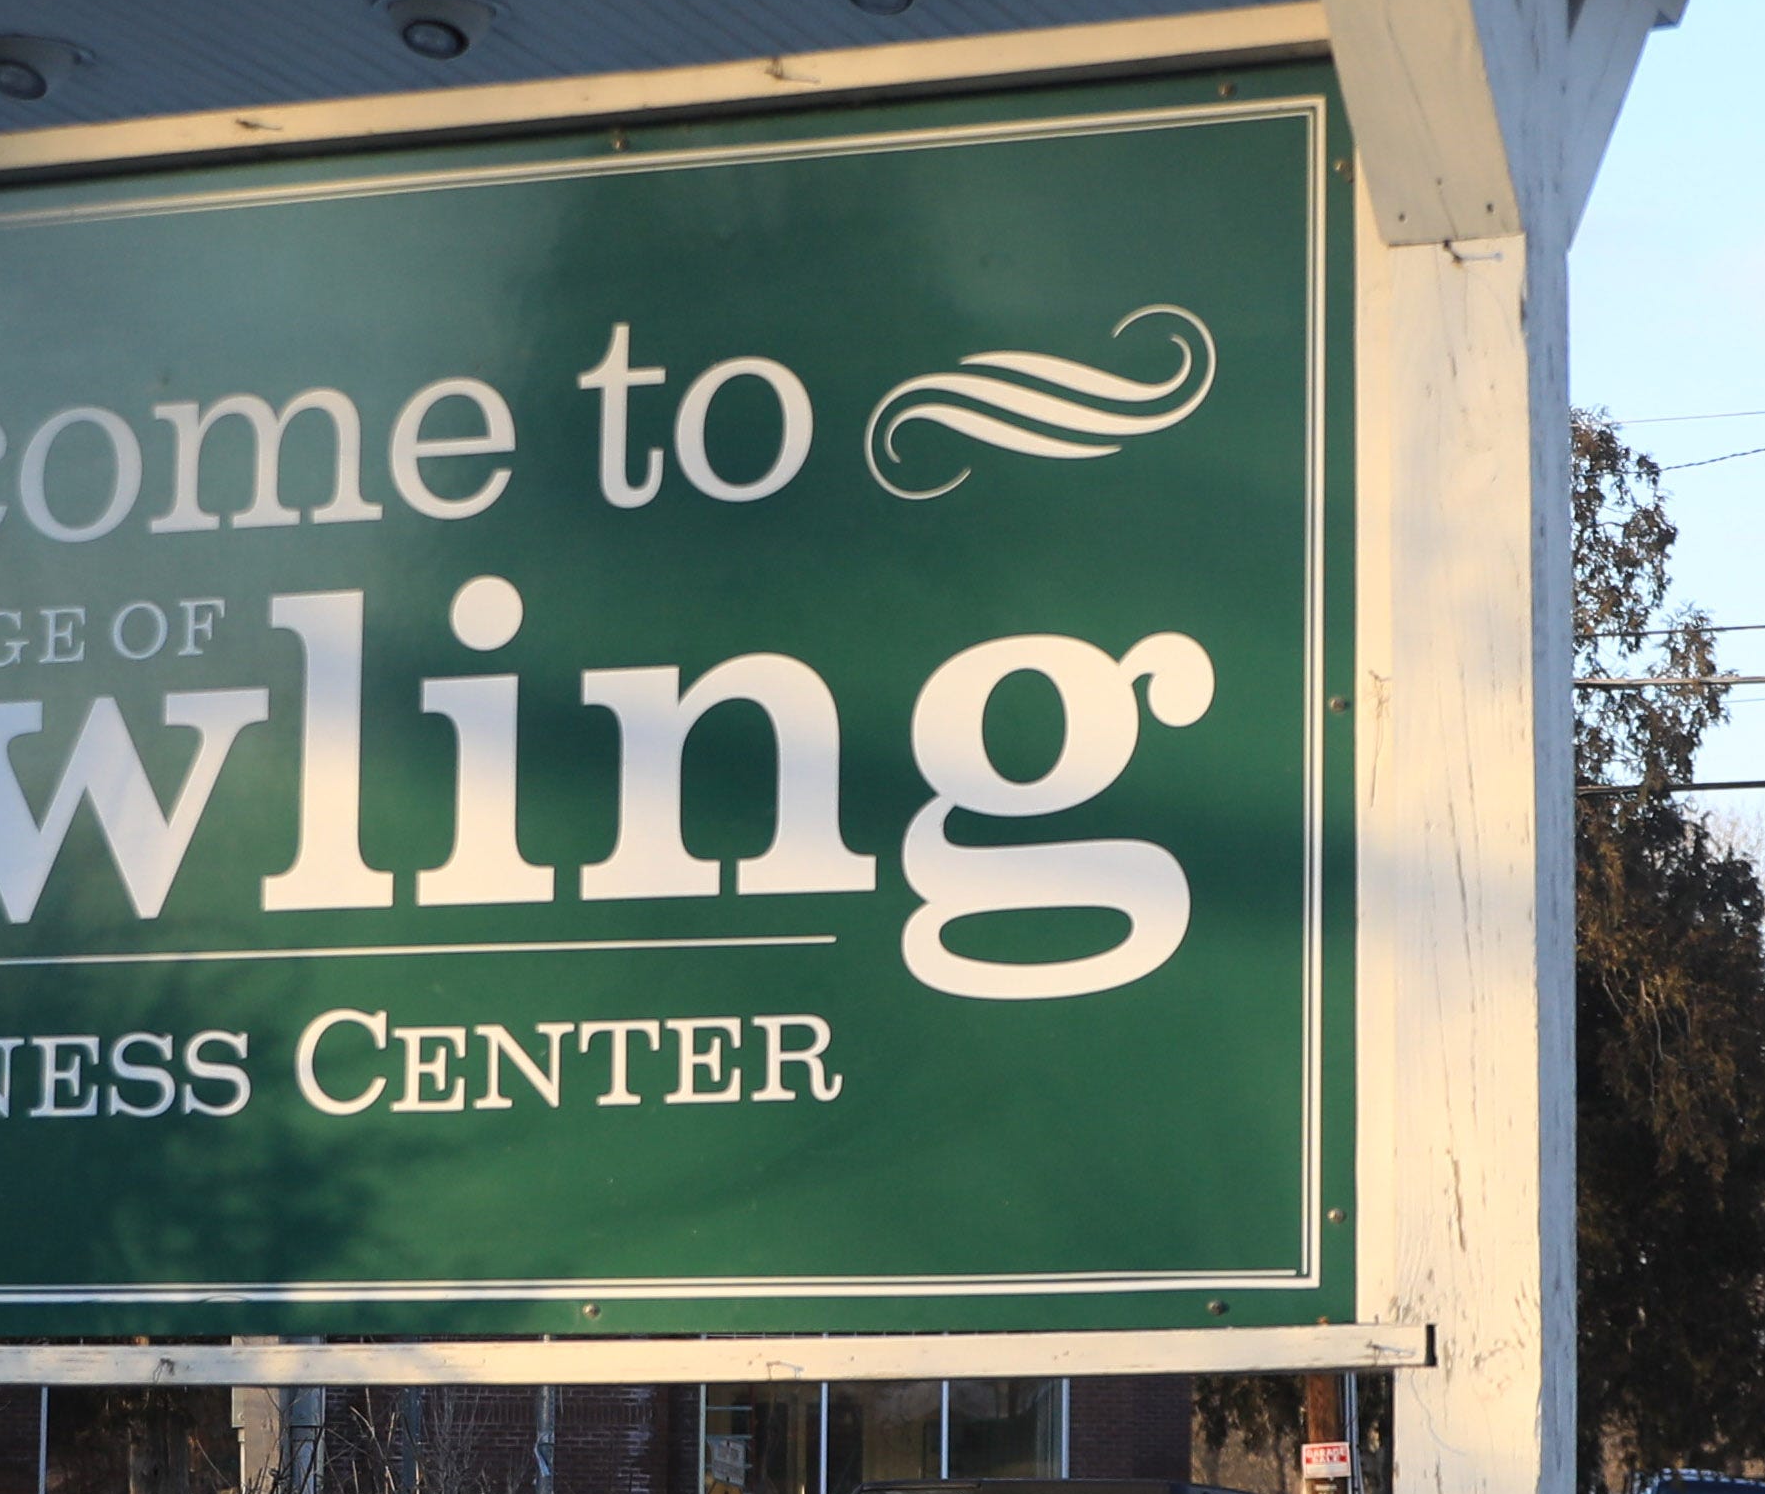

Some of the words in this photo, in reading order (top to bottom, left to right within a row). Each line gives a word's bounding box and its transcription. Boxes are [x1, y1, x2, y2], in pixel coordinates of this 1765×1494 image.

[577, 323, 815, 509] to
[111, 597, 228, 662] OF
[294, 1007, 844, 1117] CENTER
[1305, 1446, 1346, 1458] GARAGE
[1312, 1454, 1340, 1465] SALE
